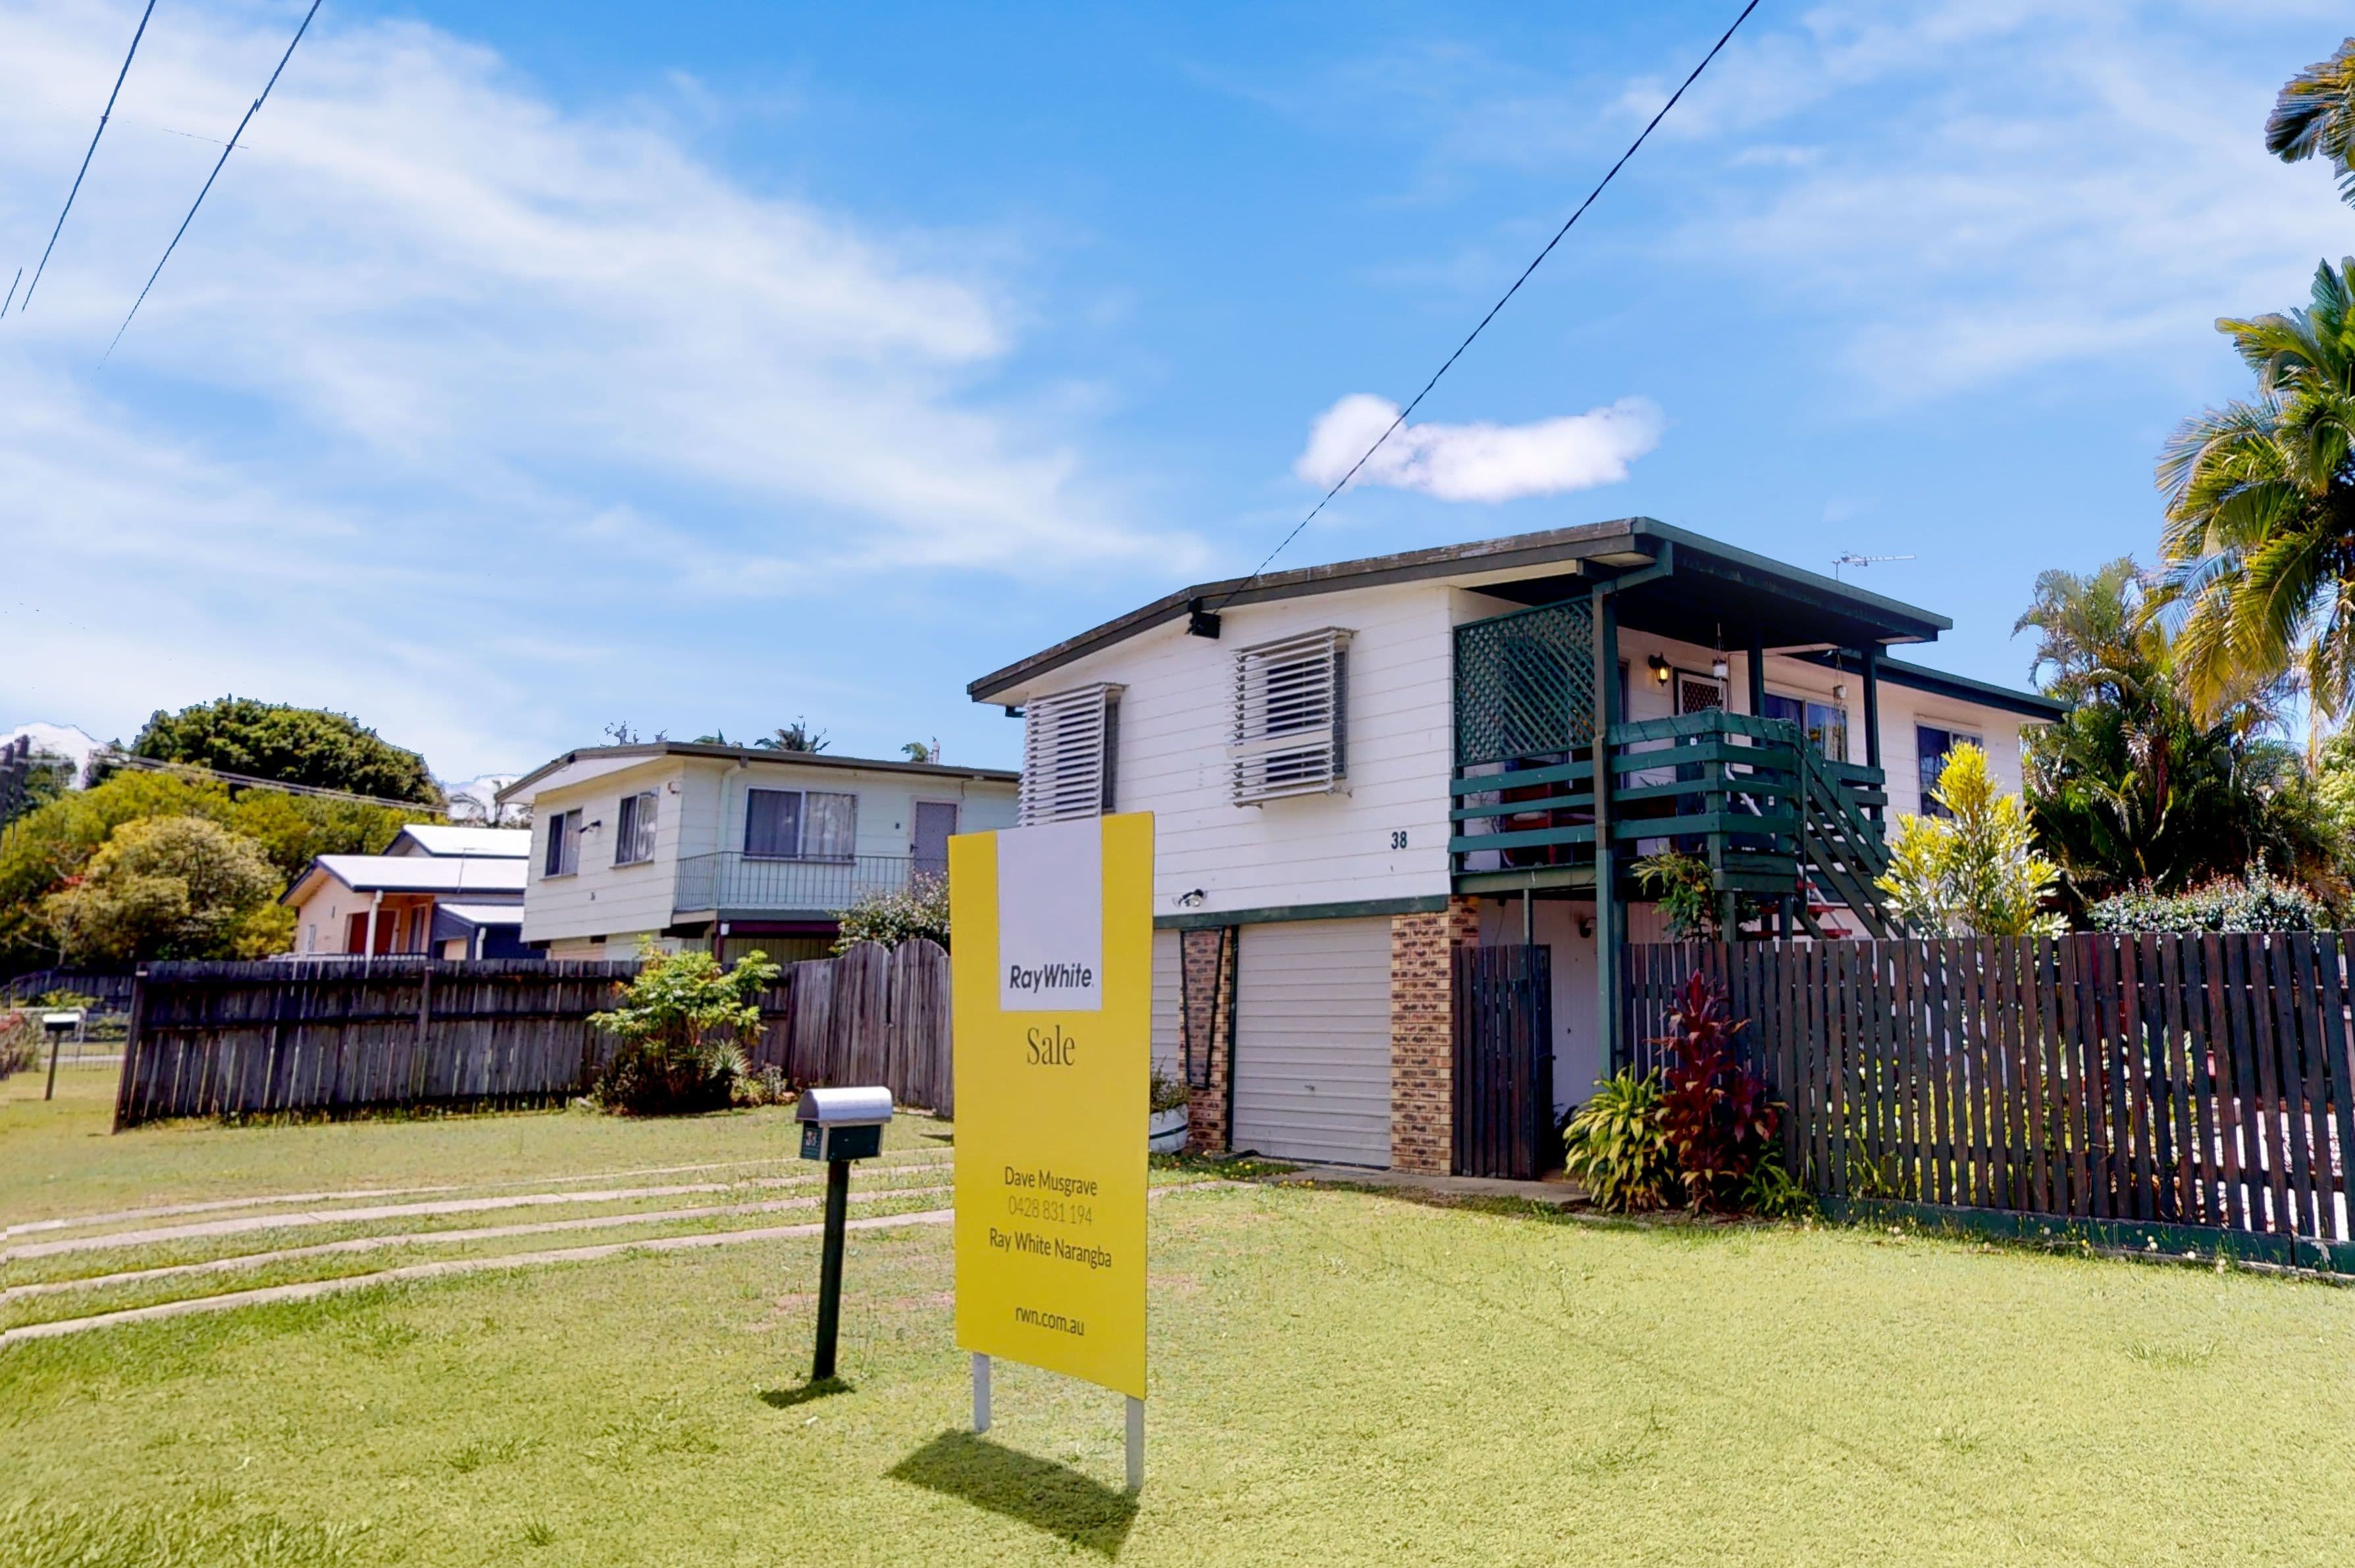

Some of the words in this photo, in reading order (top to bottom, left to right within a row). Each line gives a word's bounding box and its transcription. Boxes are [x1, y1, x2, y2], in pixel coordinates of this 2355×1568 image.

[1391, 830, 1407, 849] 38
[1027, 1024, 1075, 1066] Sale
[1004, 1166, 1035, 1187] Dave
[1038, 1169, 1098, 1197] Musgrave
[1008, 1195, 1039, 1219] 0428
[1043, 1200, 1066, 1223] 831
[1070, 1205, 1093, 1227] 194
[989, 1227, 1012, 1252] Ray
[1014, 1231, 1051, 1256] White
[1054, 1238, 1112, 1269] Narangba
[1015, 1306, 1085, 1336] rwn.com.au
